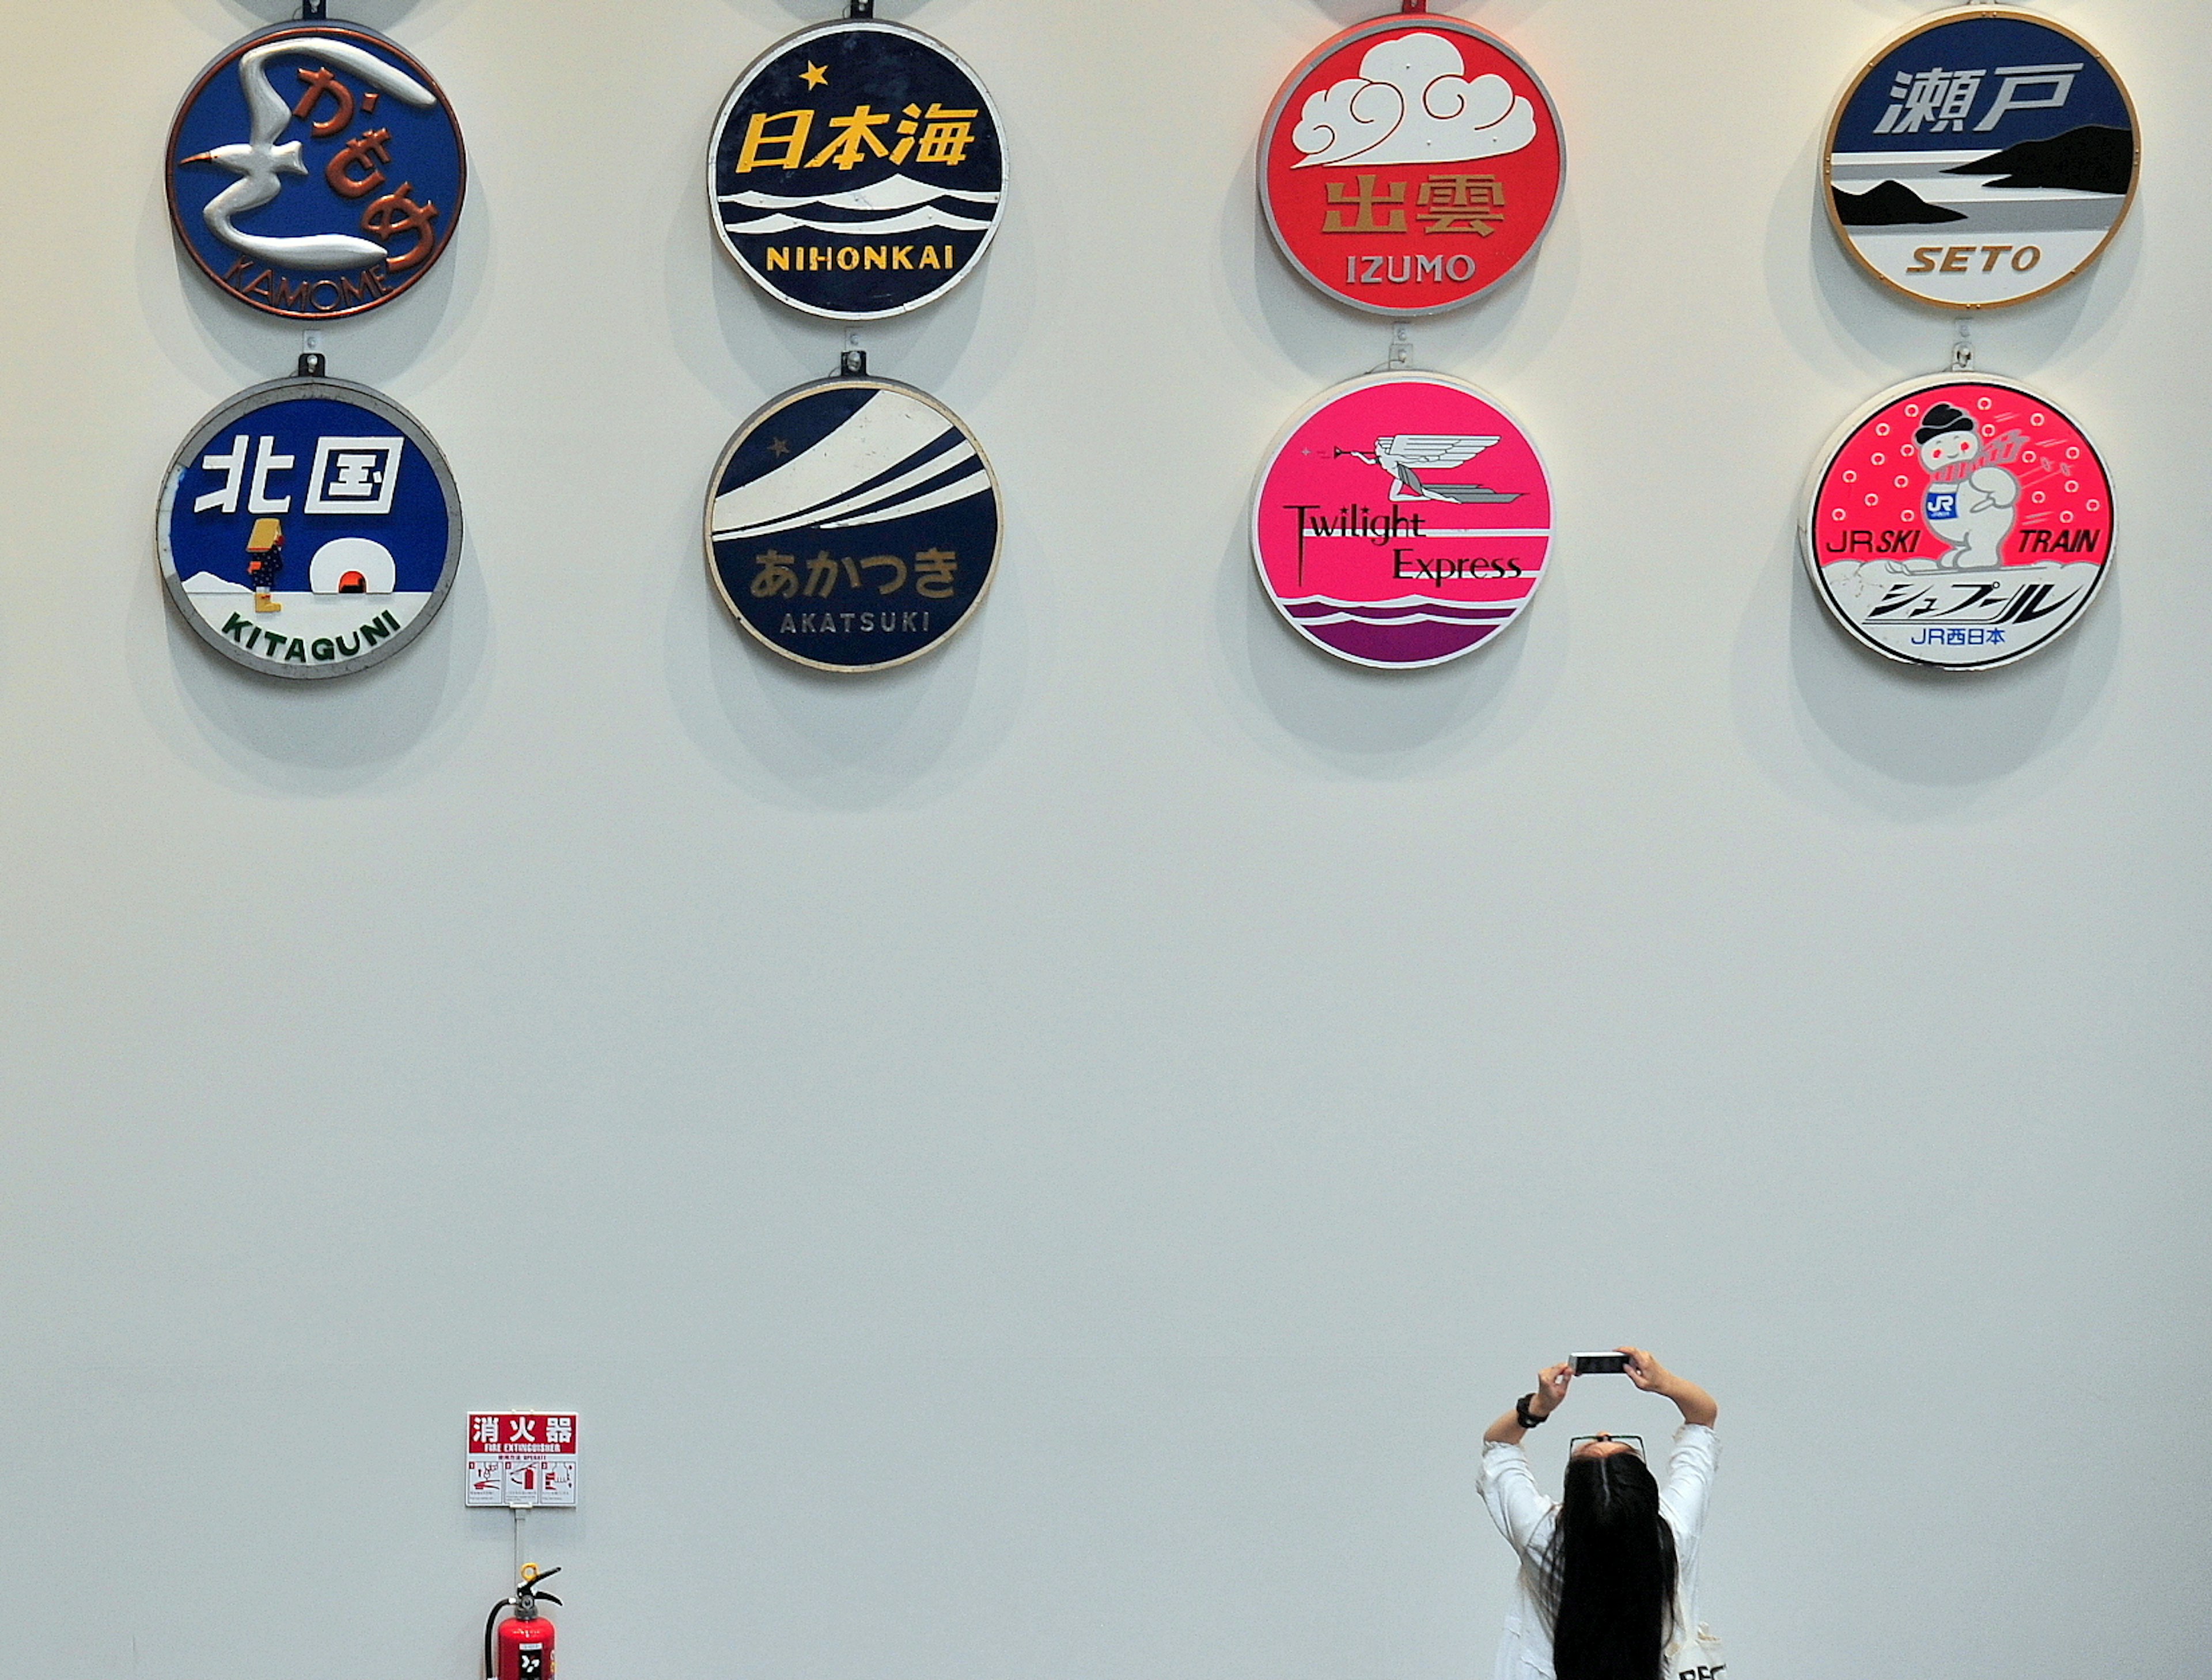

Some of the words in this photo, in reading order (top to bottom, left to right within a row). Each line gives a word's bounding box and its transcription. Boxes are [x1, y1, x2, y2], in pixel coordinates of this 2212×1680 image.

[1873, 63, 2084, 134] 瀬戸
[736, 103, 979, 173] 日本海
[291, 66, 440, 272] かもめ
[1321, 174, 1505, 238] 出雲
[767, 245, 955, 272] NIHONKAI
[1346, 255, 1476, 284] IZUMO
[1906, 246, 2041, 274] SETO
[223, 255, 393, 312] KAMOME
[194, 434, 404, 514] 北国
[1927, 495, 1954, 511] JR
[1283, 503, 1426, 587] Twilight
[2018, 529, 2101, 553] TRAIN
[749, 548, 959, 600] あかつき
[1393, 549, 1522, 587] Express
[780, 611, 929, 634] AKATSUKI
[1863, 581, 2084, 625] シュプール
[221, 609, 402, 663] KITAGUNI
[1911, 628, 2006, 646] JR西日本
[473, 1417, 572, 1443] 消火器
